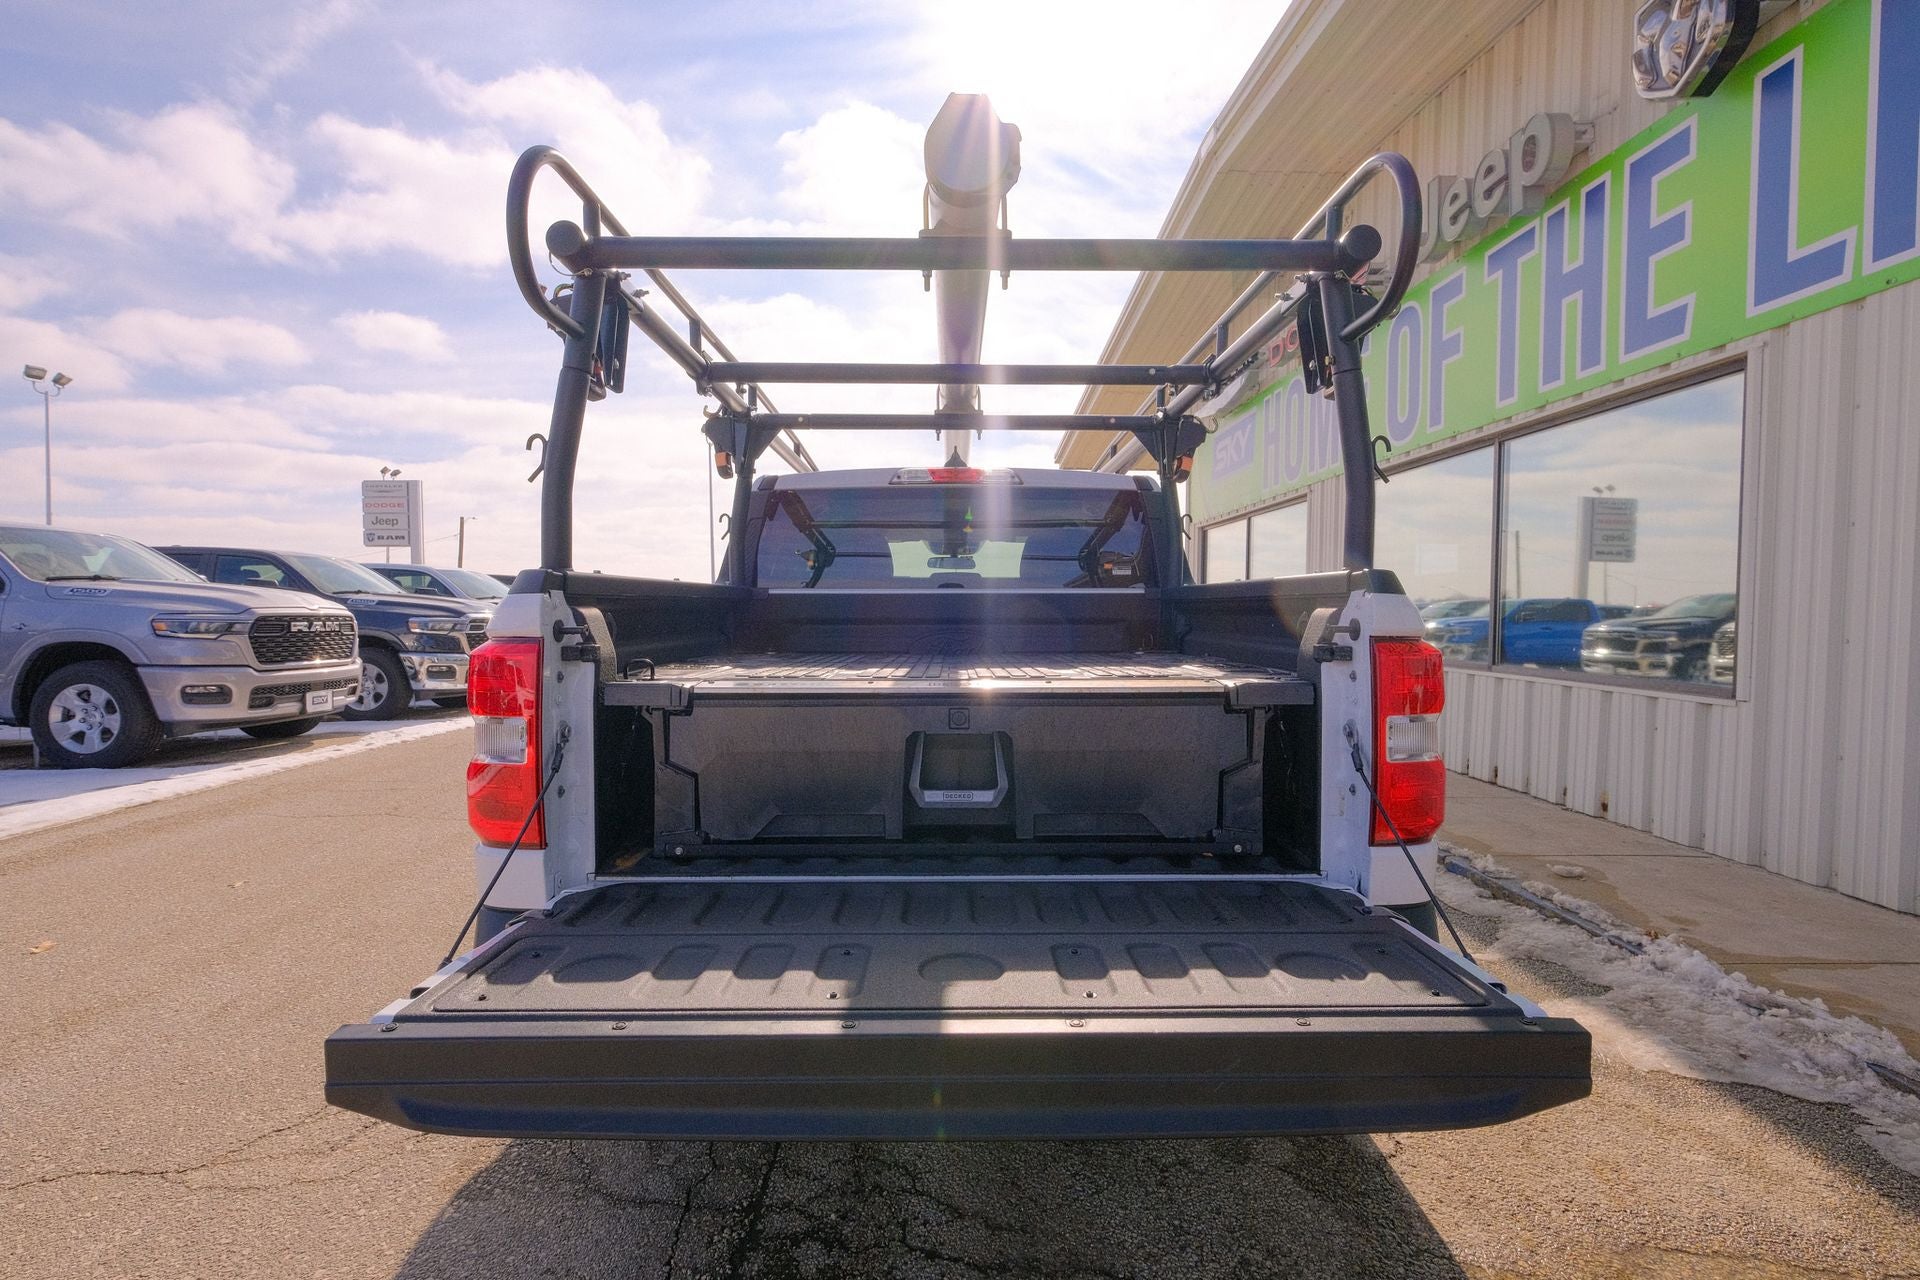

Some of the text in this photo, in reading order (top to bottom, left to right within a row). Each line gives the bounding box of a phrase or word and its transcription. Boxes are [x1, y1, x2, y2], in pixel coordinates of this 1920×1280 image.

[1417, 113, 1558, 264] Jeep
[1263, 334, 1371, 490] HOM
[1387, 271, 1465, 446] OF
[1484, 113, 1698, 409] THE
[1215, 424, 1252, 471] SKY
[371, 516, 399, 527] Jeep
[290, 621, 340, 632] RAM
